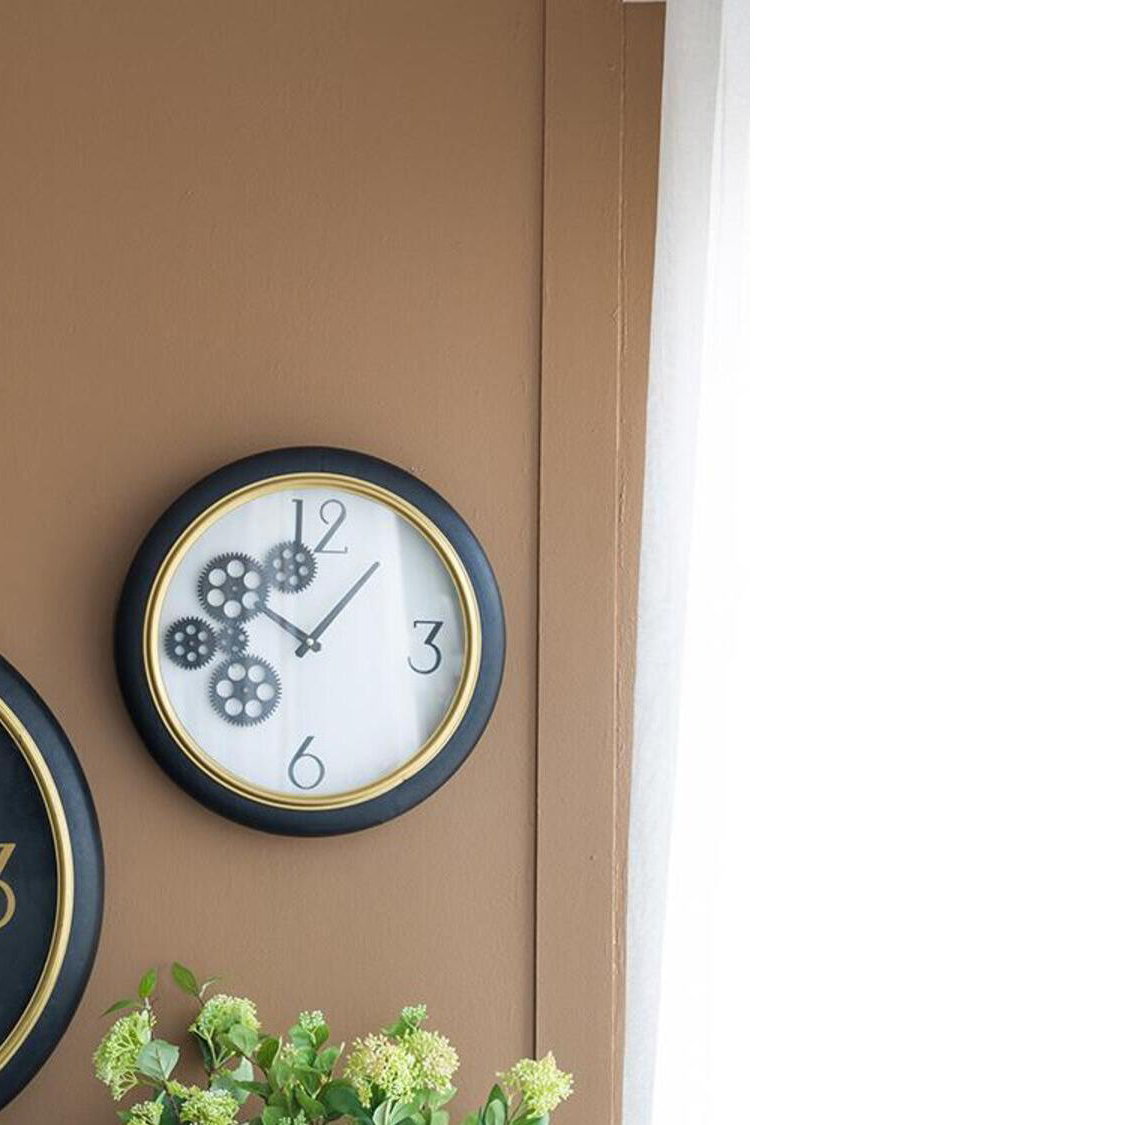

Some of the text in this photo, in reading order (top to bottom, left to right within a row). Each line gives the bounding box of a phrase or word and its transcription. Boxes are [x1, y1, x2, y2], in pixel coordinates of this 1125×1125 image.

[291, 498, 349, 555] 12
[407, 620, 444, 675] 3
[287, 735, 326, 790] 6
